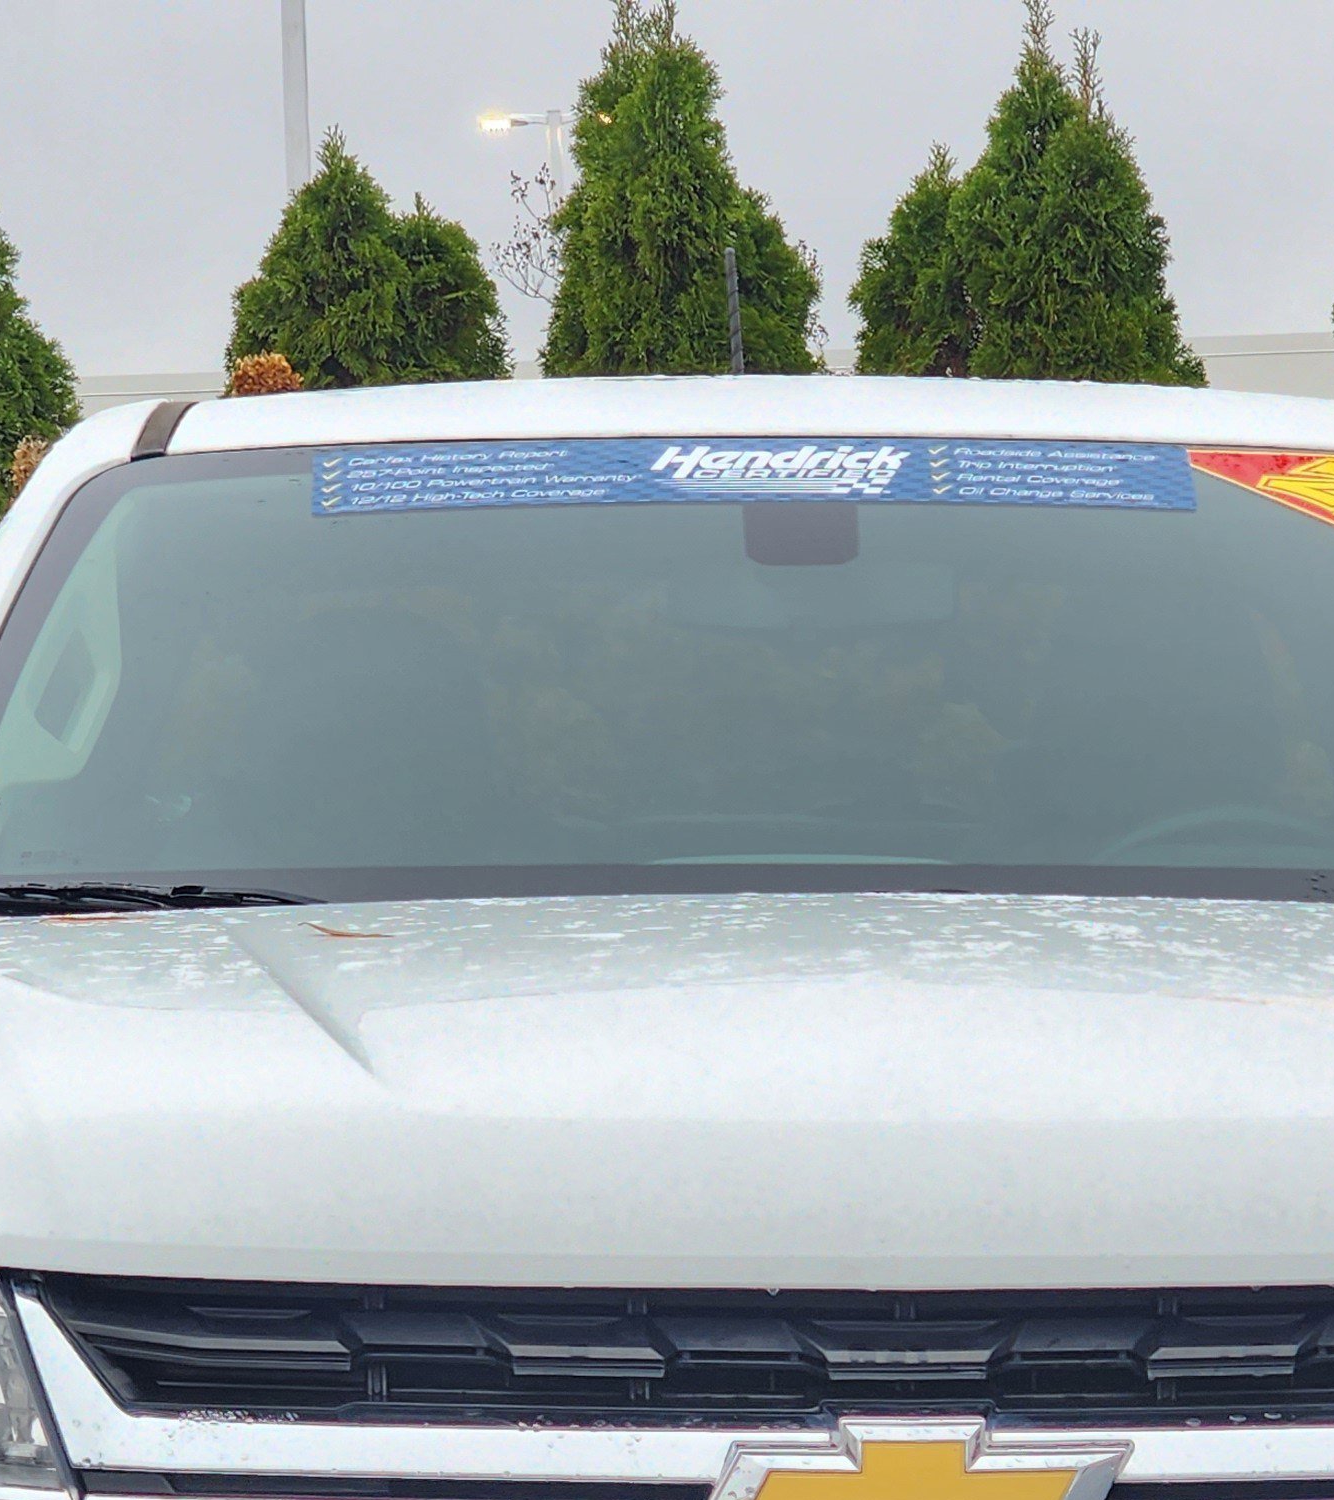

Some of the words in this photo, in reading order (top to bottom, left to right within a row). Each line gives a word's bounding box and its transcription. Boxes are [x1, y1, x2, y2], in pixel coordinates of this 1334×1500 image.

[421, 451, 492, 464] History
[499, 449, 567, 461] Report
[650, 445, 911, 479] Hendrick
[953, 447, 1042, 459] Roadside
[1047, 450, 1156, 462] Assistance
[693, 468, 897, 479] CERTIFIED
[959, 460, 991, 472] Trip
[998, 461, 1114, 474] Interruption
[350, 480, 421, 492] 10/100
[427, 476, 540, 489] Powertrain
[957, 473, 1020, 484] Rental
[351, 493, 407, 505] 12/12
[412, 489, 504, 503] High-Tech
[958, 487, 983, 496] Oil
[989, 487, 1064, 499] Change
[1070, 489, 1156, 501] Services
